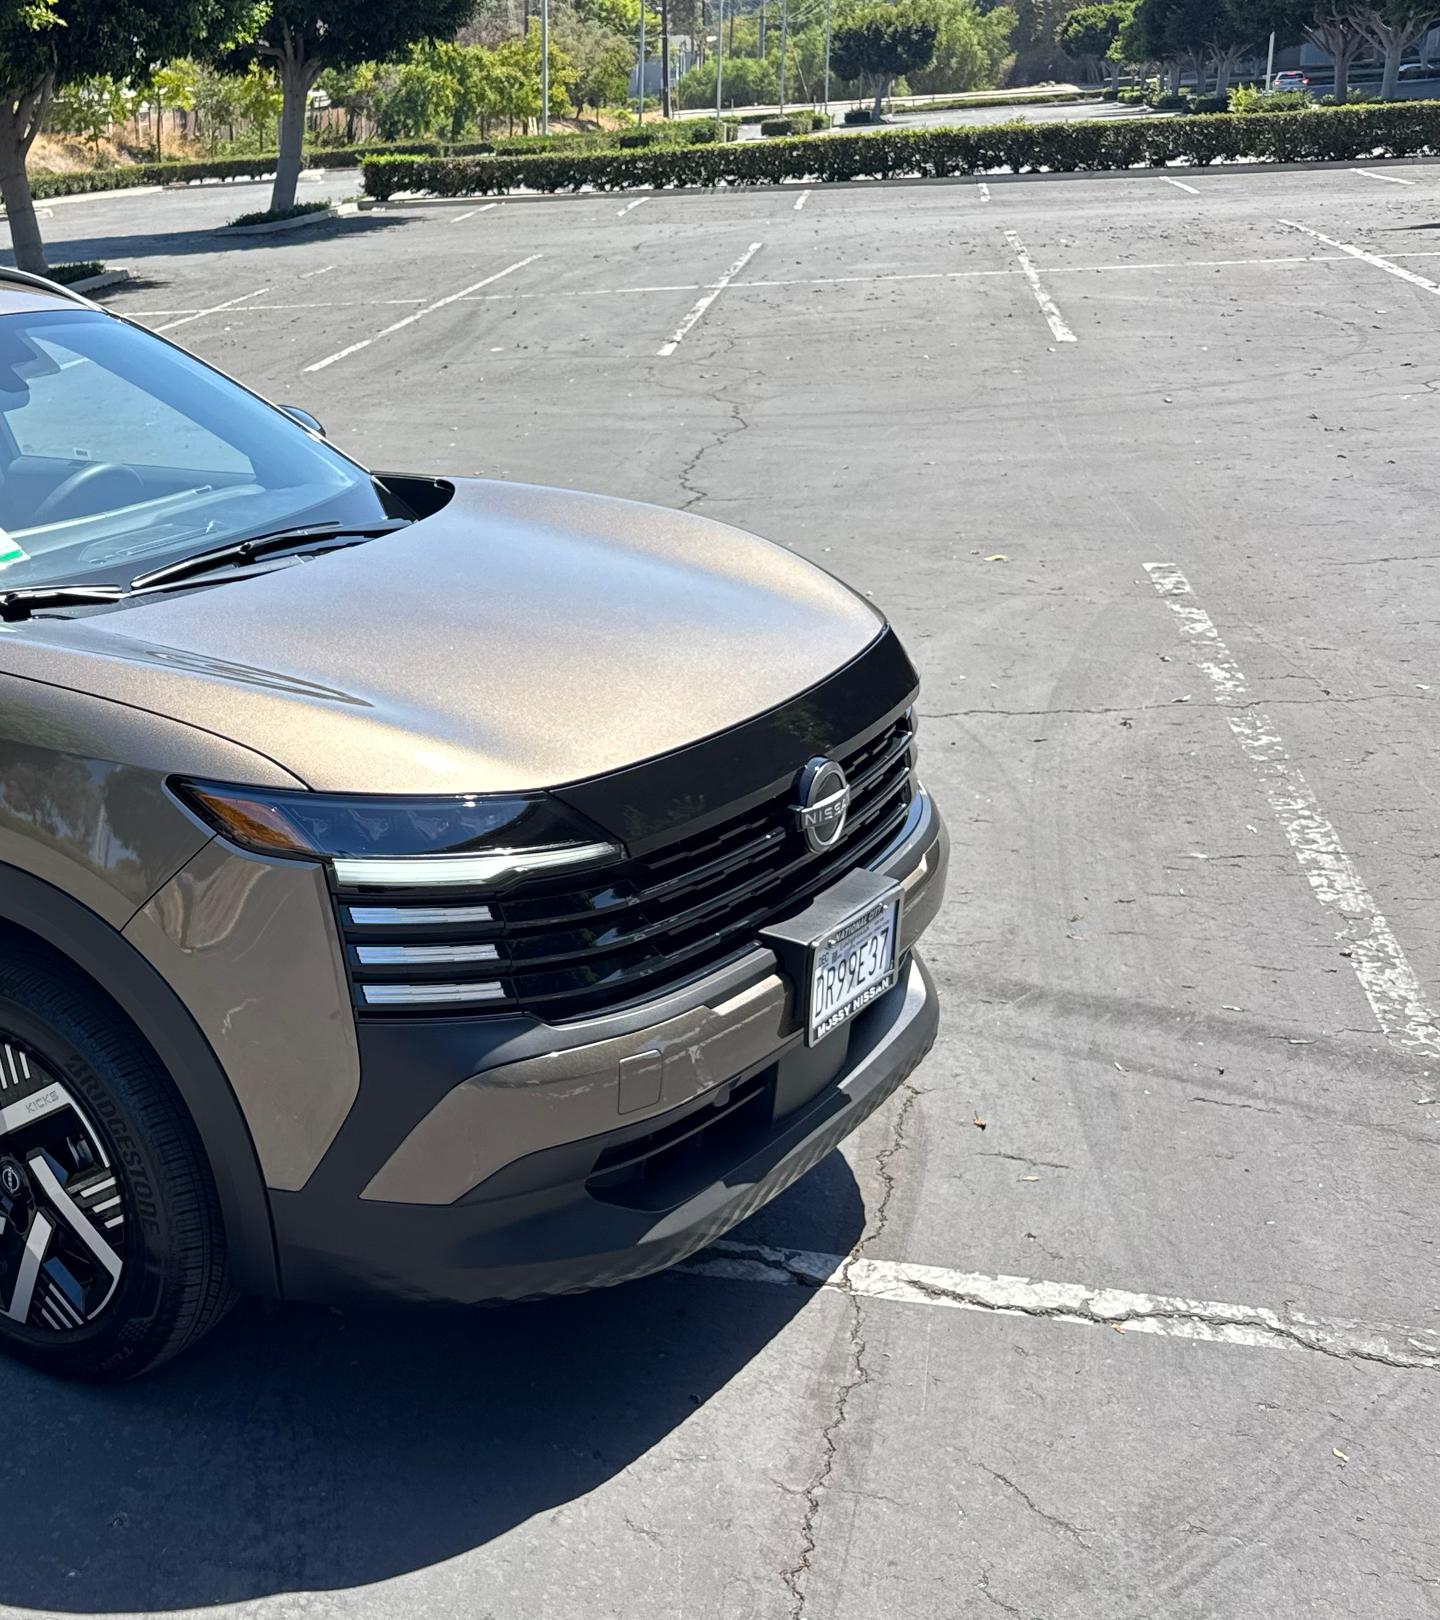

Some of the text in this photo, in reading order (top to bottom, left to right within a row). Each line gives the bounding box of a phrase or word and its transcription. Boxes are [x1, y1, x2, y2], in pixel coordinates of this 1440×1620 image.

[815, 926, 889, 1019] DR99E37
[817, 977, 890, 1038] MOSSY NISSAN
[25, 1090, 60, 1113] KICKS
[64, 1053, 160, 1236] BRIDGESTONE
